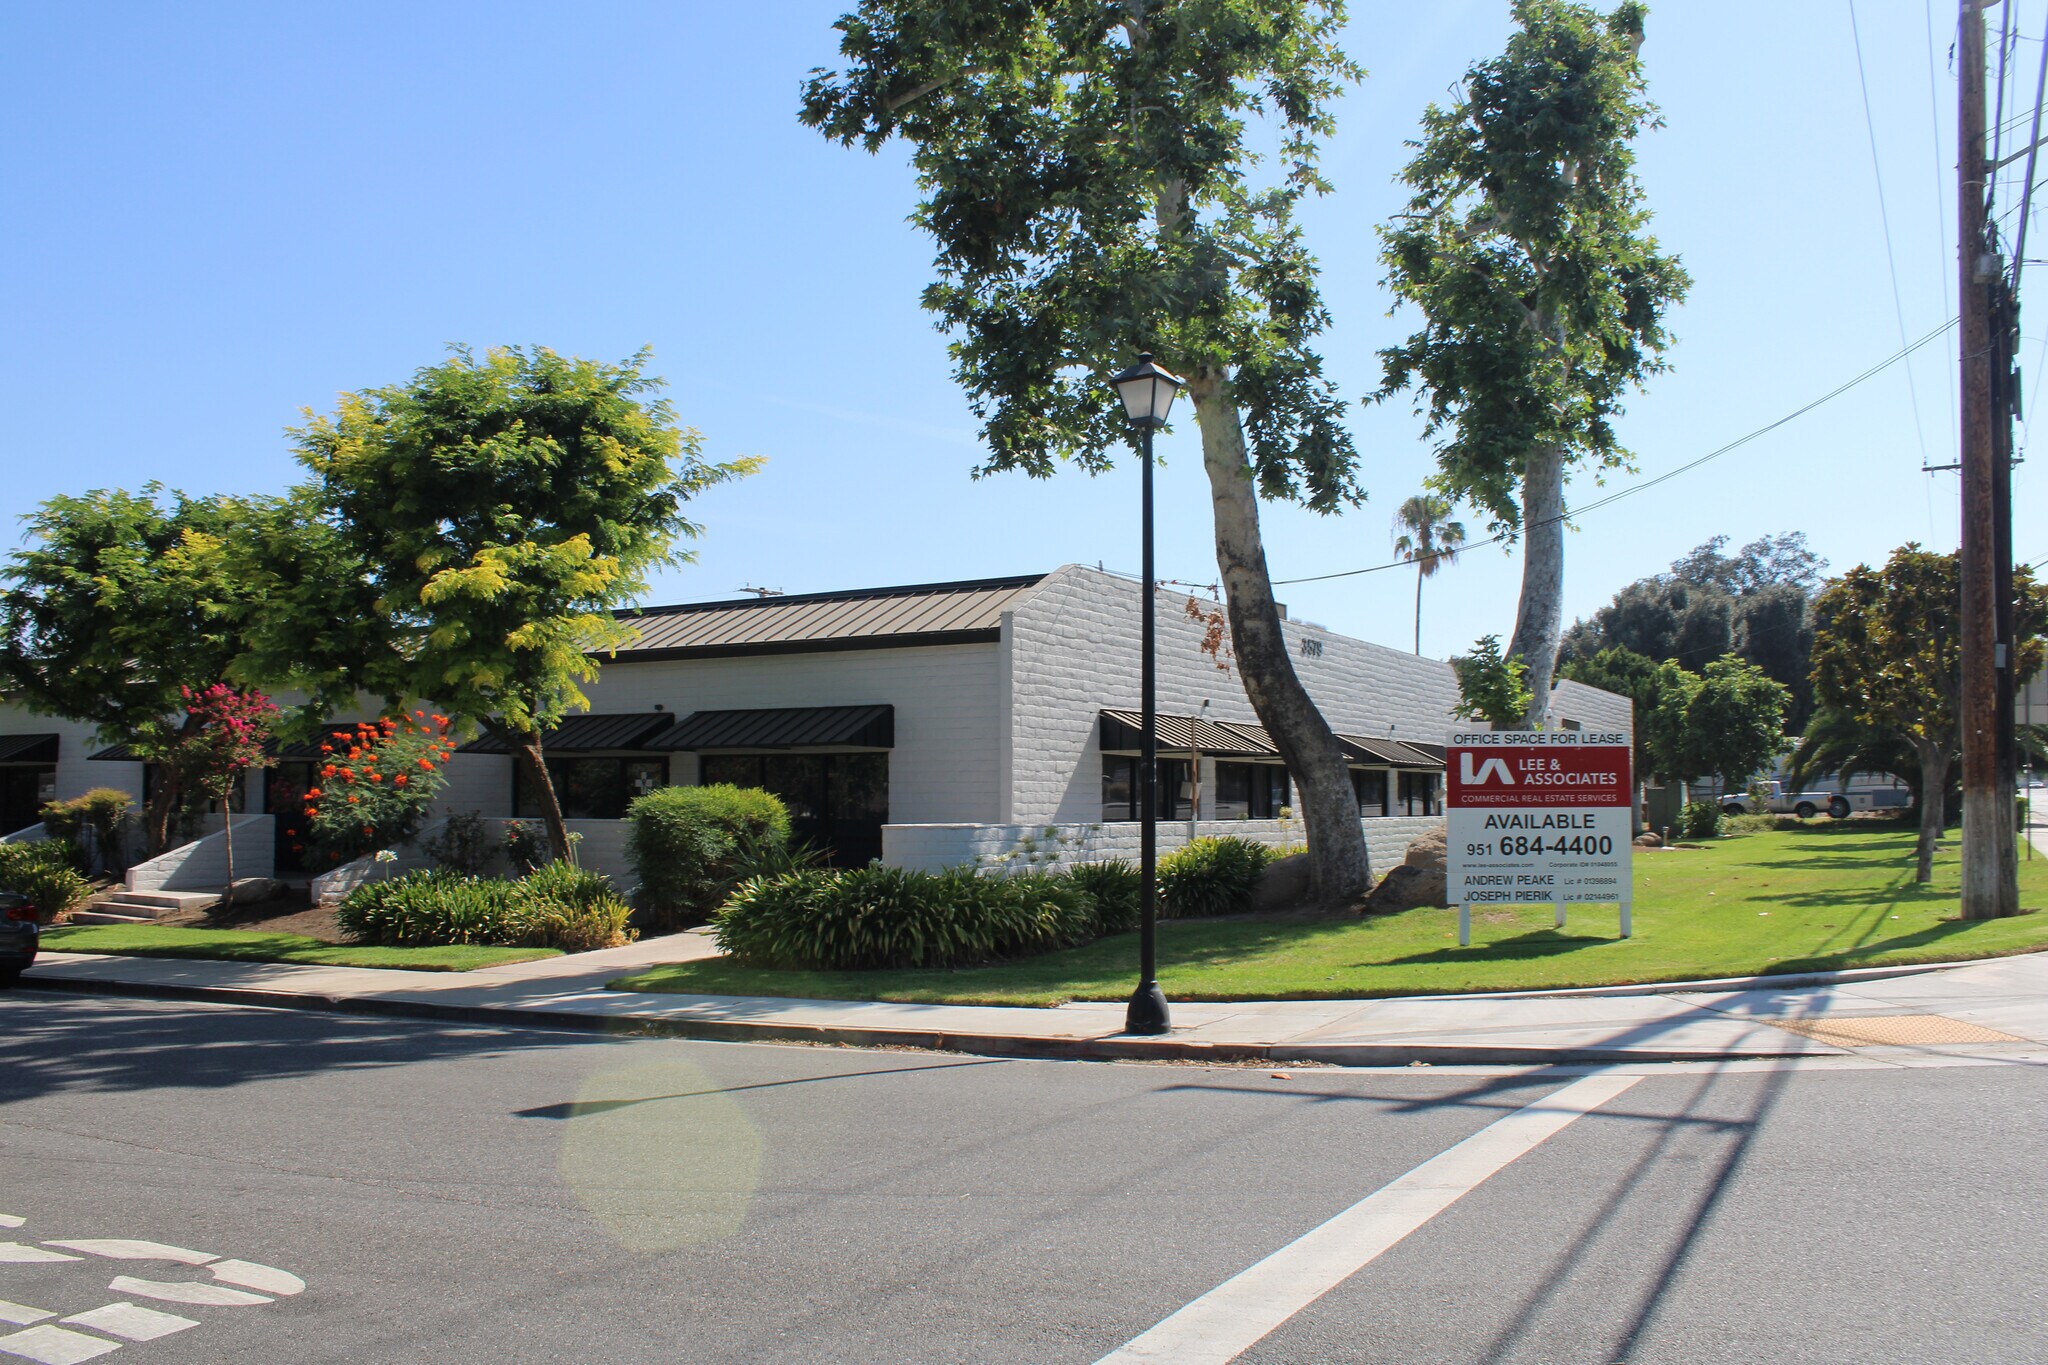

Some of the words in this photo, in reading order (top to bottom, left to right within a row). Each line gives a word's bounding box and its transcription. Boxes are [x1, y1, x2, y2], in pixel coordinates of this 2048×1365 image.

[1453, 734, 1500, 745] OFFICE
[1504, 734, 1546, 744] SPACE
[1551, 733, 1578, 744] FOR
[1581, 733, 1623, 744] LEASE
[1519, 759, 1545, 771] LEE
[1550, 758, 1561, 771] &
[1524, 772, 1617, 785] ASSOCIATES
[1461, 795, 1519, 803] COMMERCIAL
[1545, 794, 1574, 802] ESTATE
[1577, 794, 1617, 802] SERVICES
[1485, 814, 1595, 829] AVAILABLE
[1467, 843, 1492, 856] 951
[1500, 835, 1613, 856] 684-4400
[1464, 875, 1513, 886] ANDREW
[1517, 875, 1554, 885] PEAKE
[1463, 891, 1511, 902] JOSEPH
[1515, 891, 1553, 901] PIERIK
[1563, 893, 1574, 901] Lic
